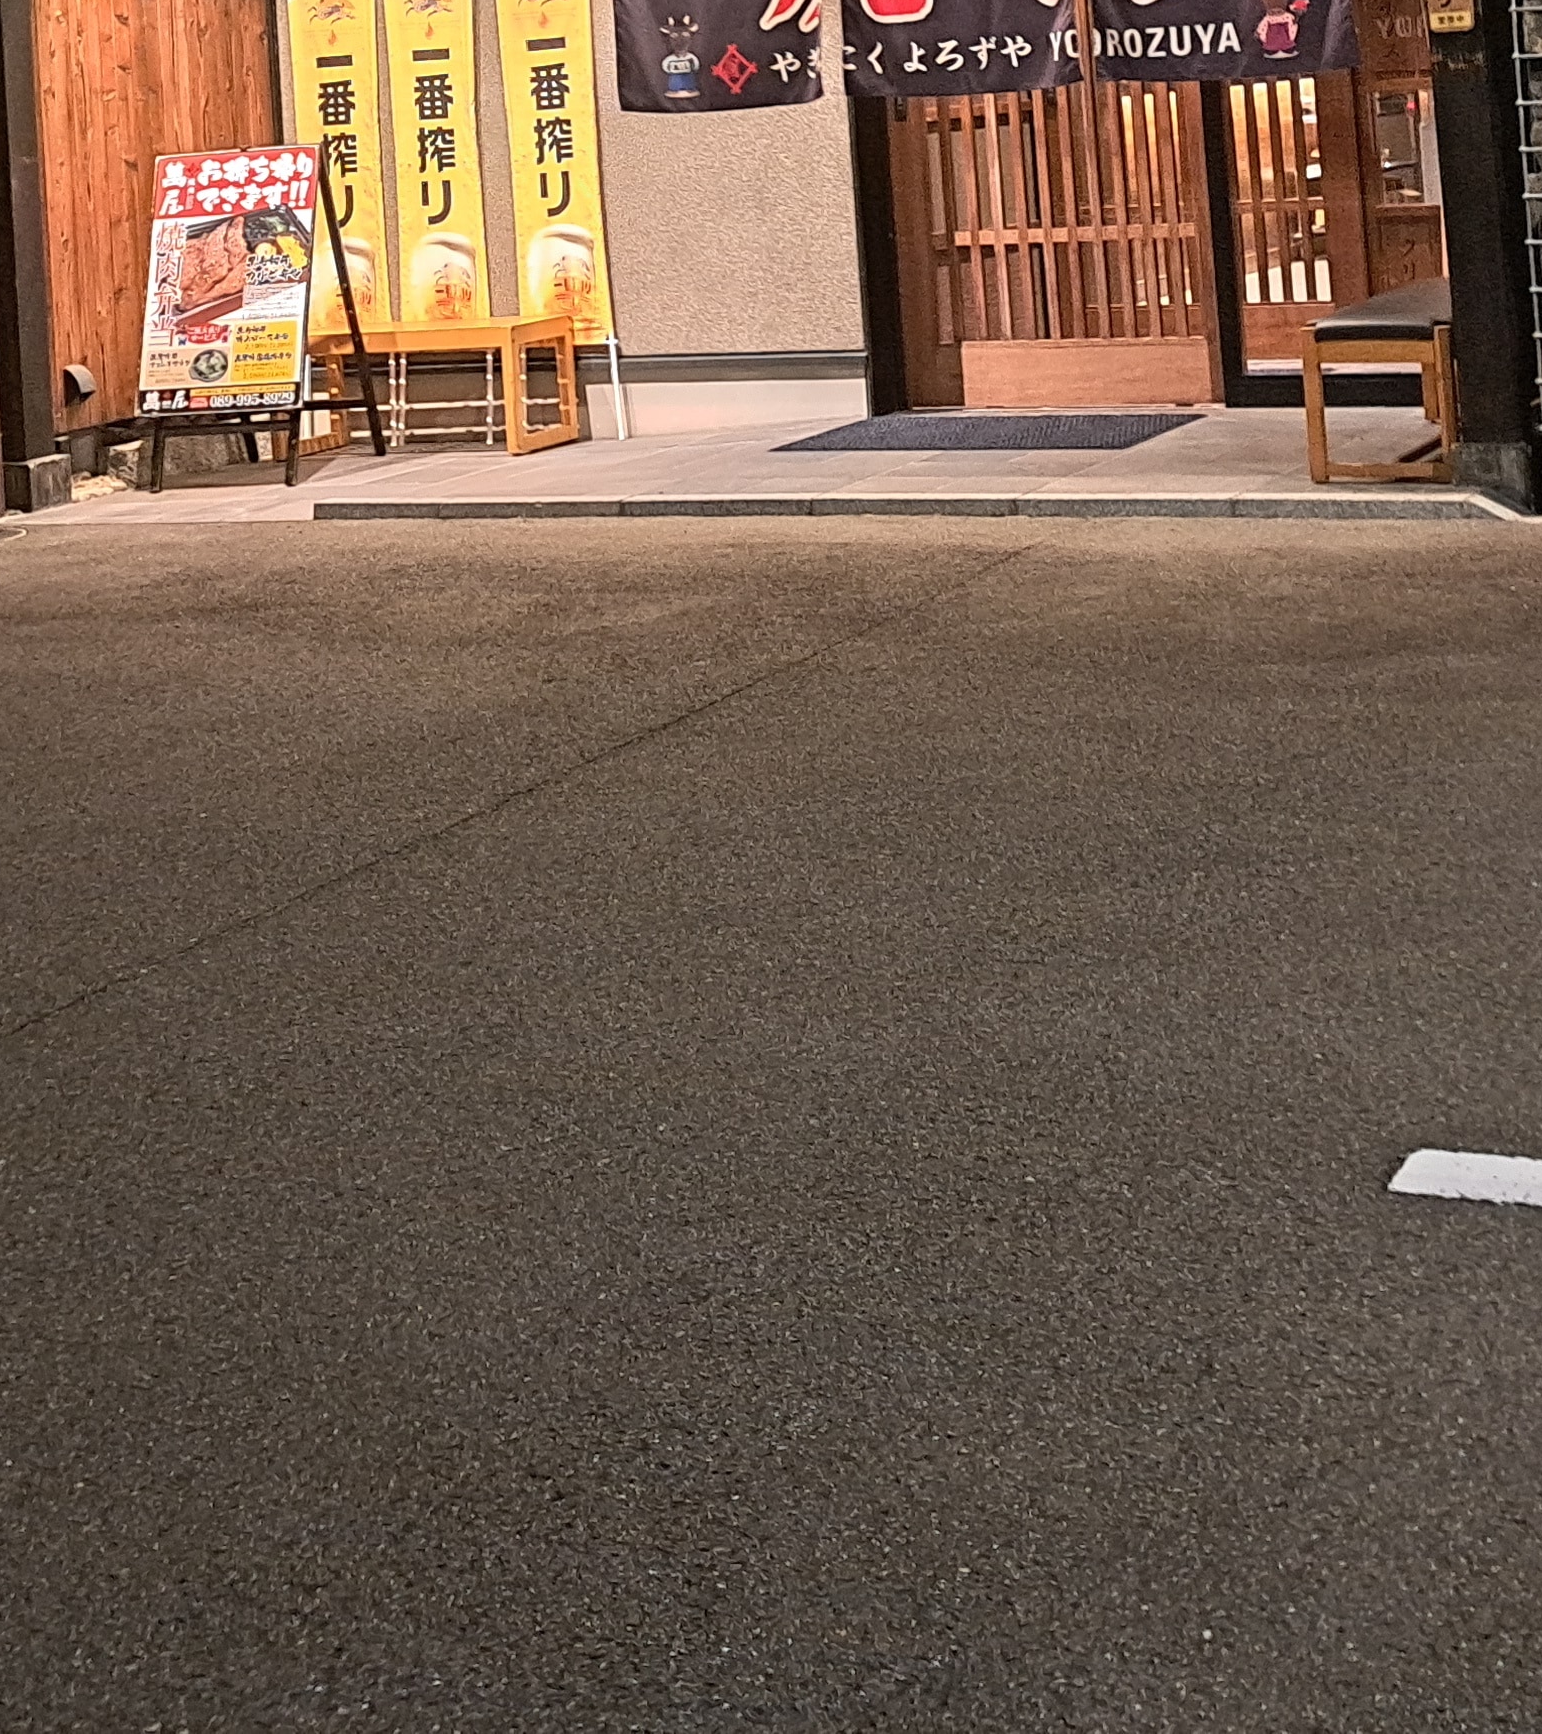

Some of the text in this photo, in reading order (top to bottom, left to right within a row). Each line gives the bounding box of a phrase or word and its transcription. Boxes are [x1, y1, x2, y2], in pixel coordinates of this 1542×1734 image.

[901, 35, 1034, 74] よろずや
[197, 151, 313, 187] お持ち帰り
[411, 46, 458, 226] 一番搾り
[524, 36, 574, 218] 一番搾り
[148, 220, 186, 347] 焼肉弁当
